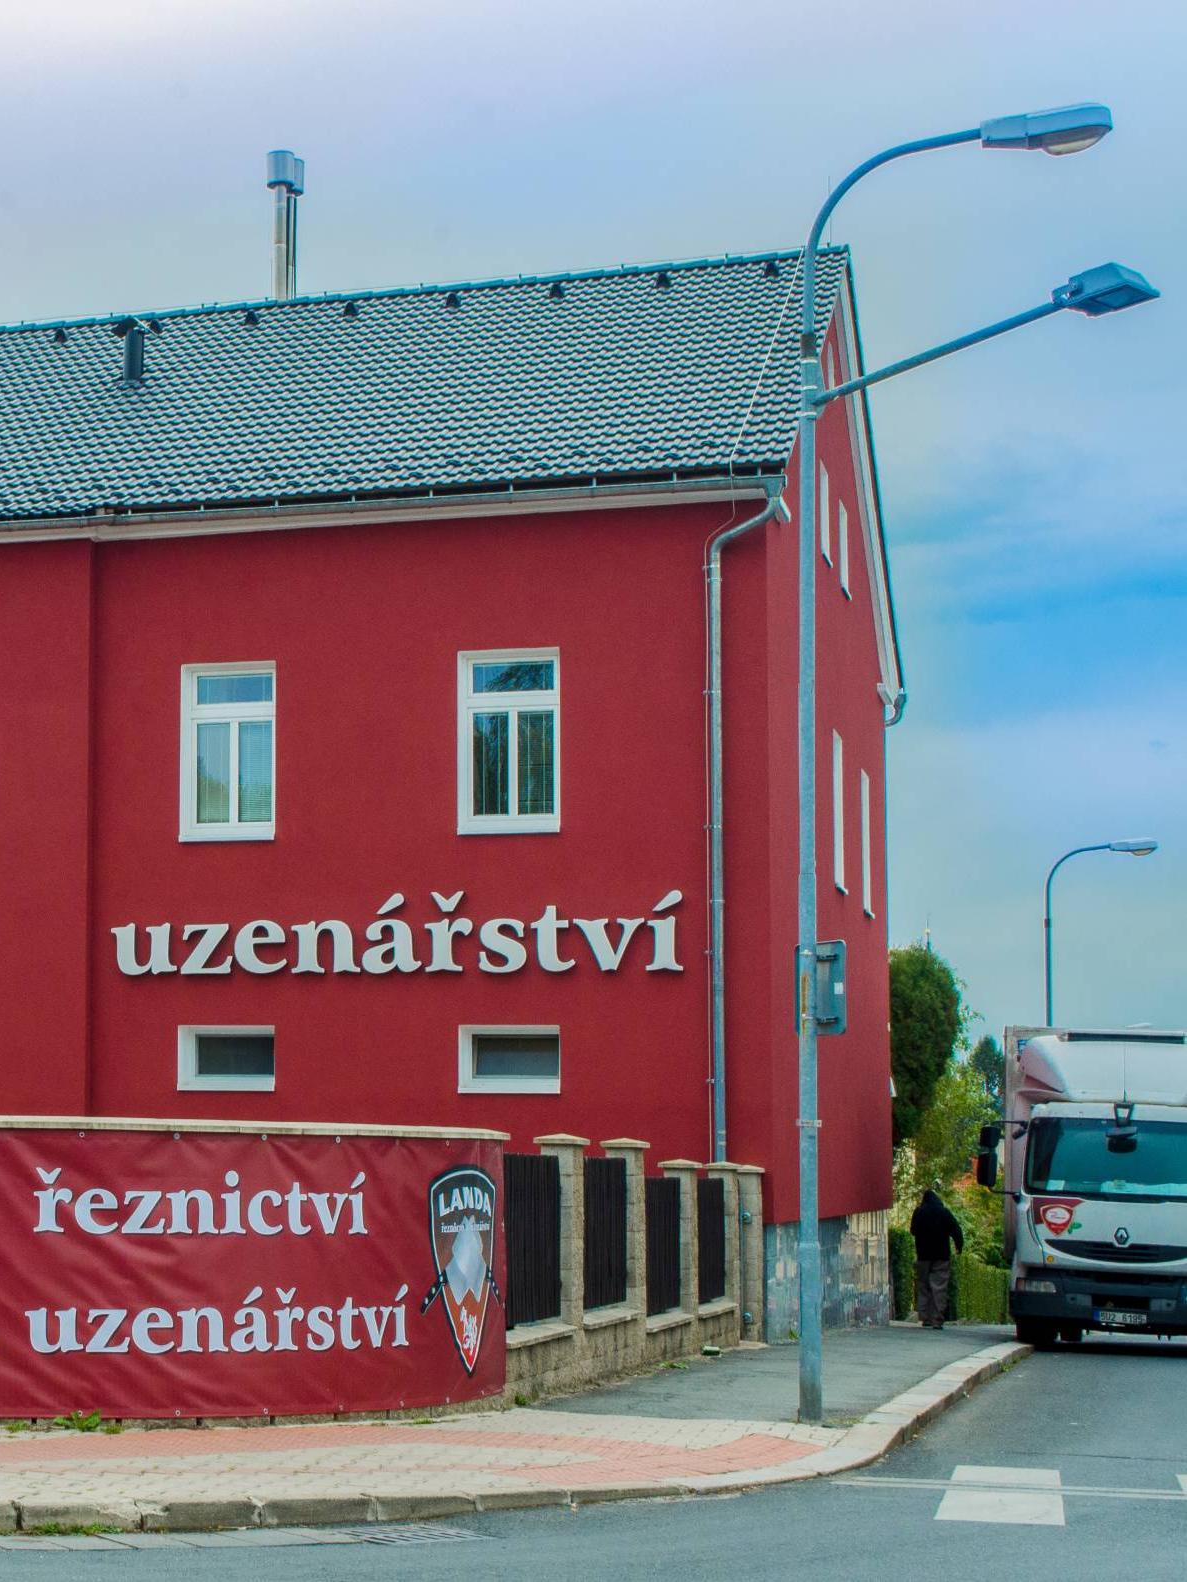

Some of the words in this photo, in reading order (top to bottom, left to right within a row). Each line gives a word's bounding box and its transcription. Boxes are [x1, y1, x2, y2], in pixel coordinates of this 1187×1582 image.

[110, 890, 685, 976] uzenářství
[32, 1167, 368, 1236] řeznictví
[438, 1186, 492, 1218] LANDA
[24, 1284, 410, 1354] uzenářství
